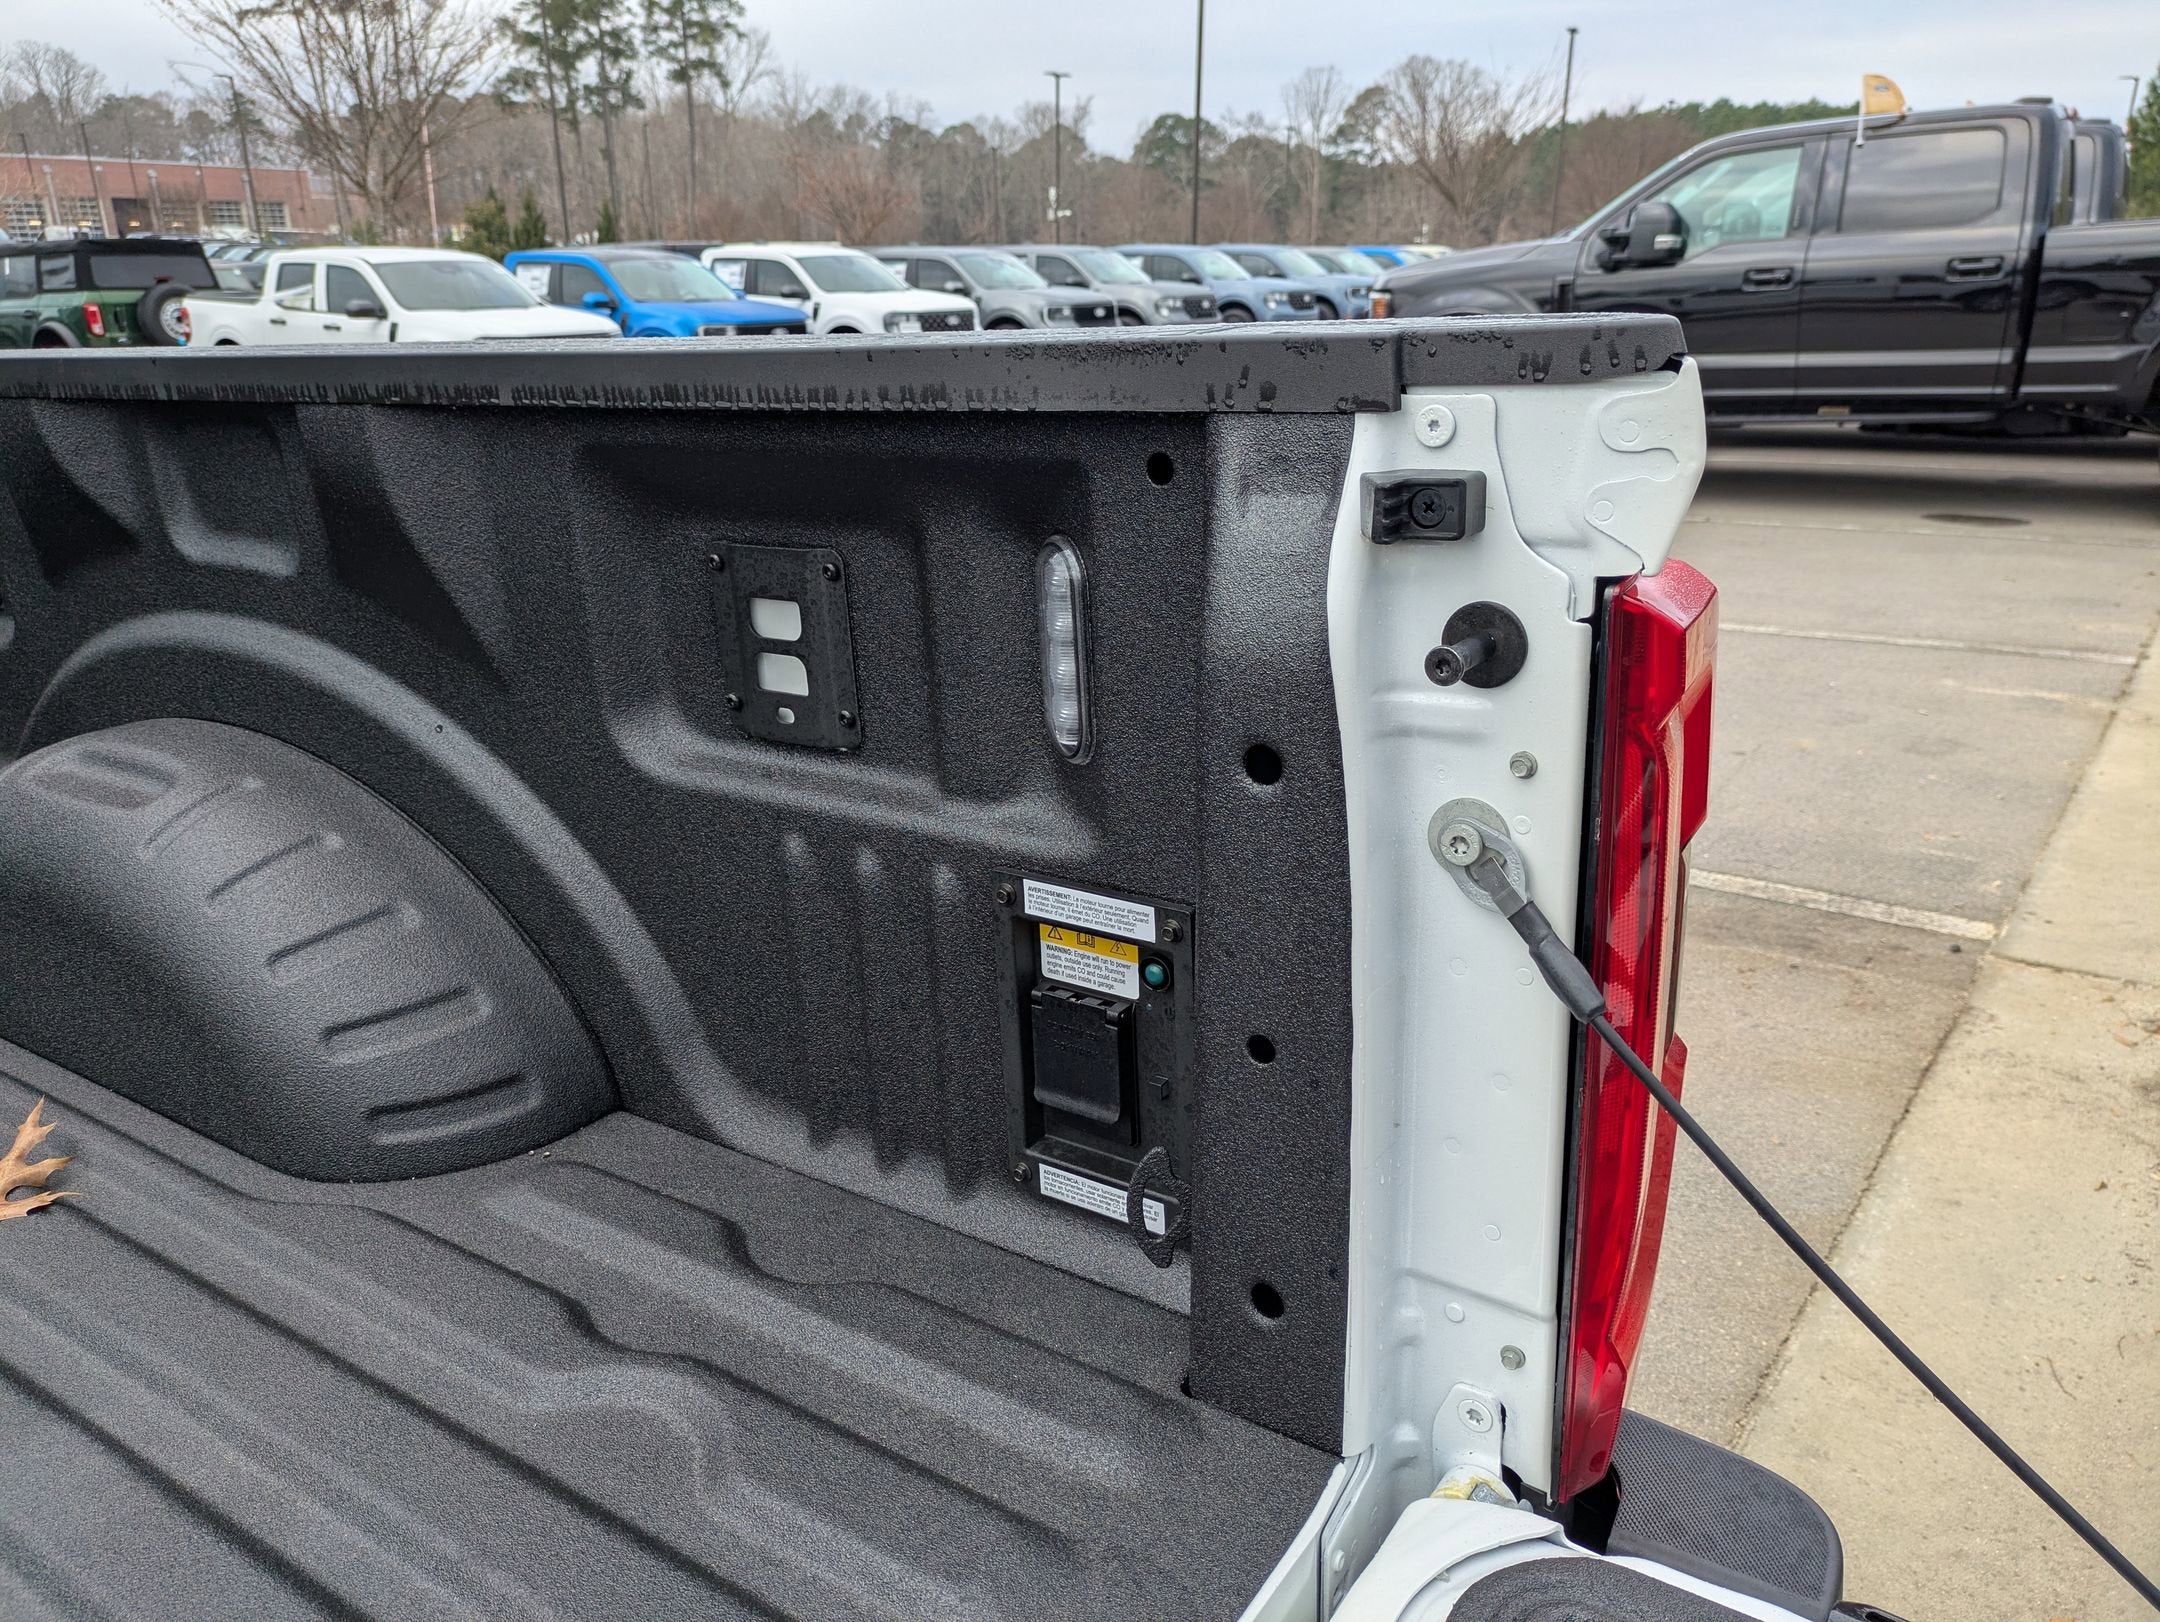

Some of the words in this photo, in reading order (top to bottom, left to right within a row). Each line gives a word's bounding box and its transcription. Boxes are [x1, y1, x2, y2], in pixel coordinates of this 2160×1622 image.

[1027, 886, 1072, 901] AVERTISSEMENT:
[1046, 944, 1073, 956] WARNING:
[1074, 950, 1090, 962] Engine
[1116, 961, 1131, 971] power
[1064, 956, 1081, 966] outside
[1105, 966, 1125, 978] Running
[1047, 960, 1062, 970] engine
[1064, 964, 1076, 972] emits
[1087, 969, 1095, 977] and
[1097, 971, 1109, 980] could
[1111, 976, 1126, 984] cause
[1047, 967, 1060, 976] death
[1065, 971, 1077, 980] used
[1078, 974, 1092, 984] inside
[1043, 1169, 1080, 1186] ADVERTENCIA:
